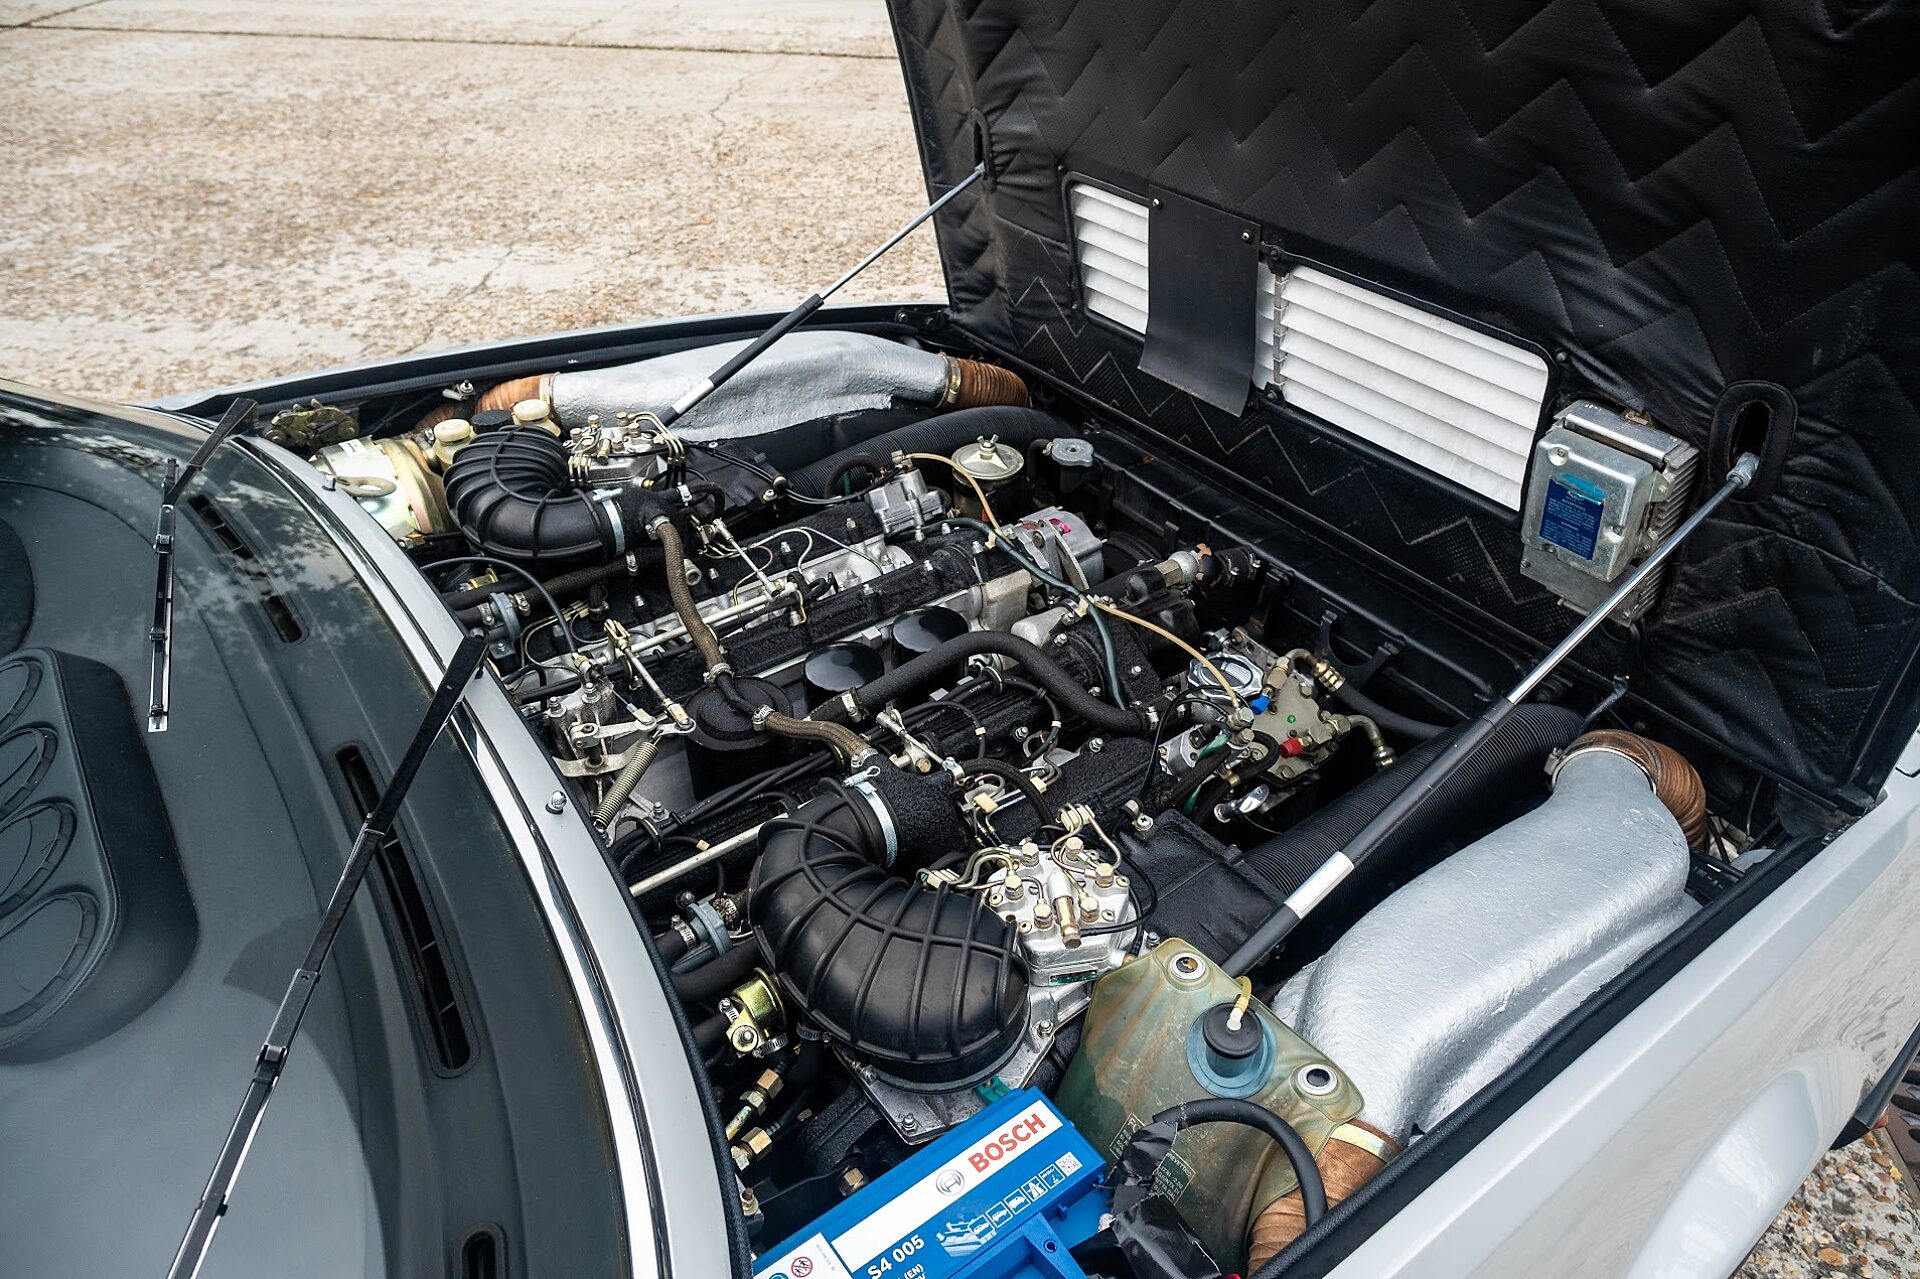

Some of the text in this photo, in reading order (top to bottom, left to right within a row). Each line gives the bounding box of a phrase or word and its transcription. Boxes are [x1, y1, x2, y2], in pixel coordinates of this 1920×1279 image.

[968, 1113, 1046, 1173] BOSCH
[867, 1234, 925, 1279] S4 005
